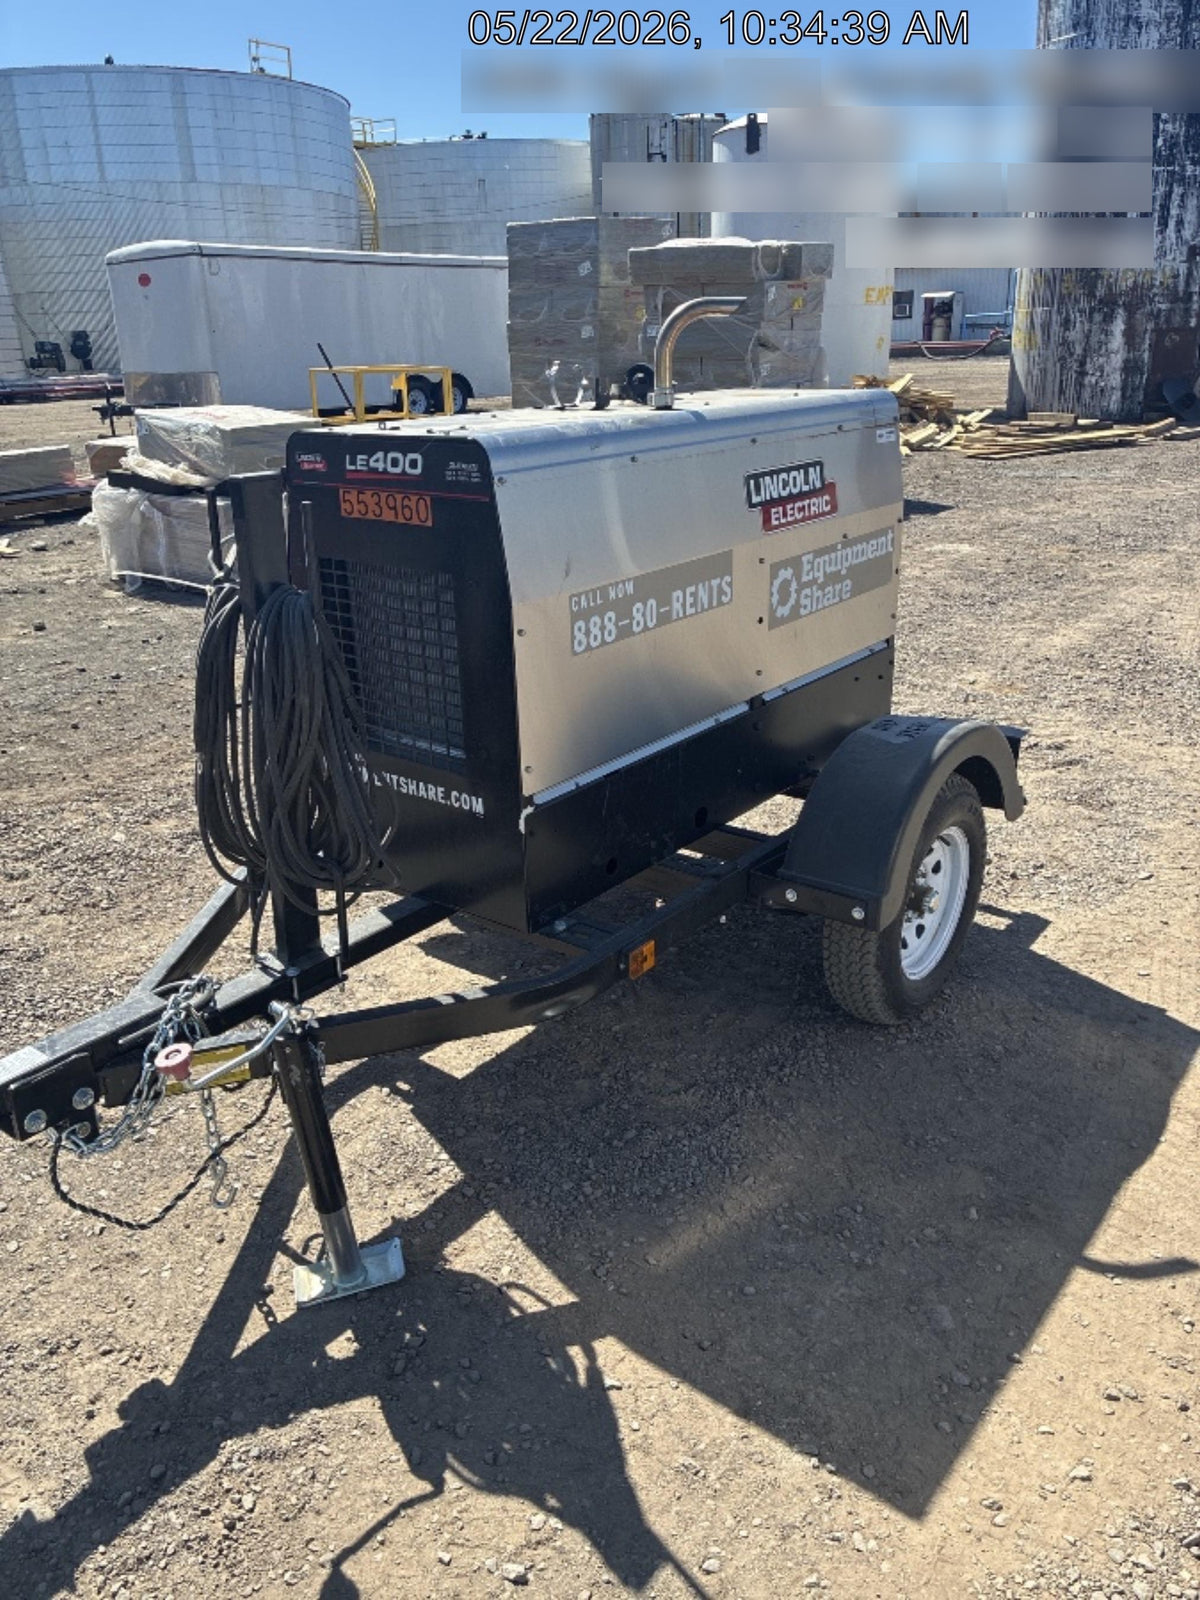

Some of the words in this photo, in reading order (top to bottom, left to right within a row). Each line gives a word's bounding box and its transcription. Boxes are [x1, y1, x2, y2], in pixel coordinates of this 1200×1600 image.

[346, 451, 423, 475] LE400
[750, 465, 821, 503] LINCOLN
[342, 490, 429, 524] 553960
[771, 494, 831, 525] ELECTRIC
[801, 529, 893, 583] Equipment
[571, 590, 603, 613] CALL
[609, 580, 634, 600] NOW
[573, 575, 732, 653] 888-80-RENTS
[800, 579, 852, 615] Share
